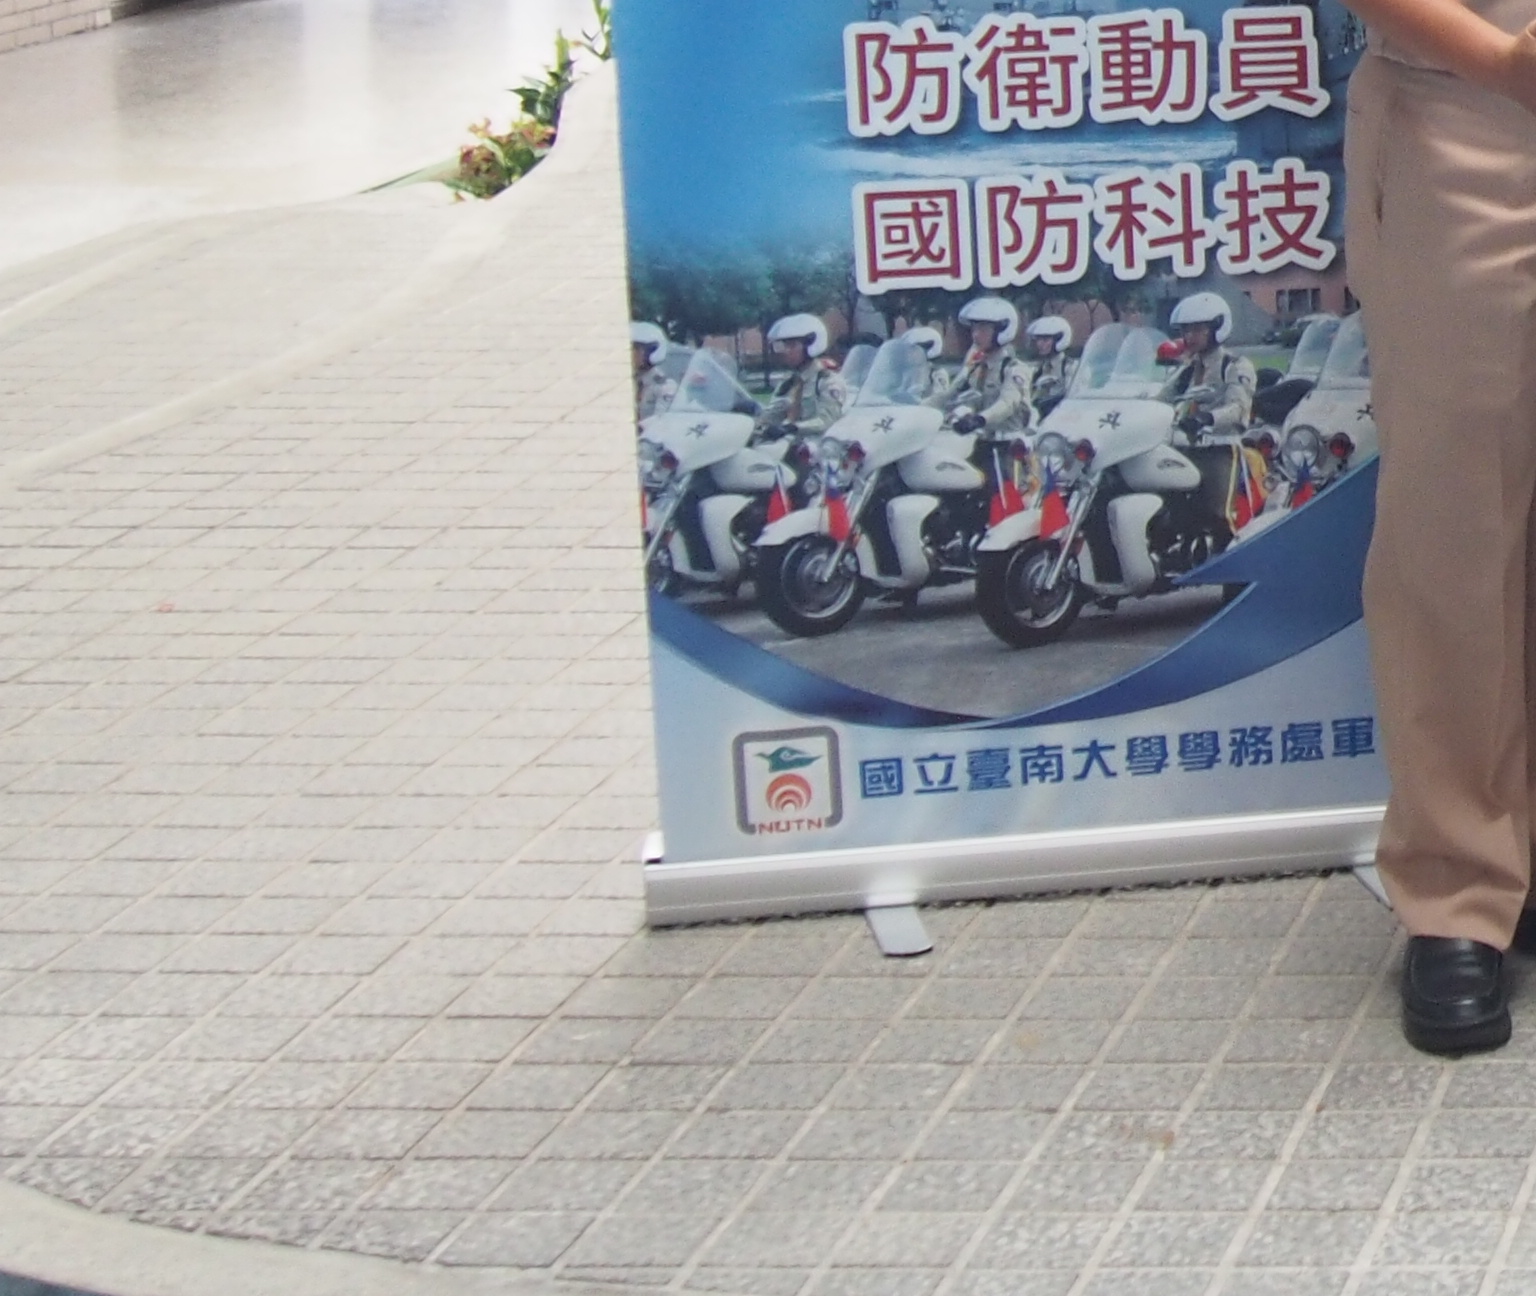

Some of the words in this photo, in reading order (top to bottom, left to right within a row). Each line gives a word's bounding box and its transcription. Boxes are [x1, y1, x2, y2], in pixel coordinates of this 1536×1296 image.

[854, 12, 1324, 127] 防衛動員
[861, 165, 1334, 285] 國防科技
[758, 816, 824, 835] NUTN
